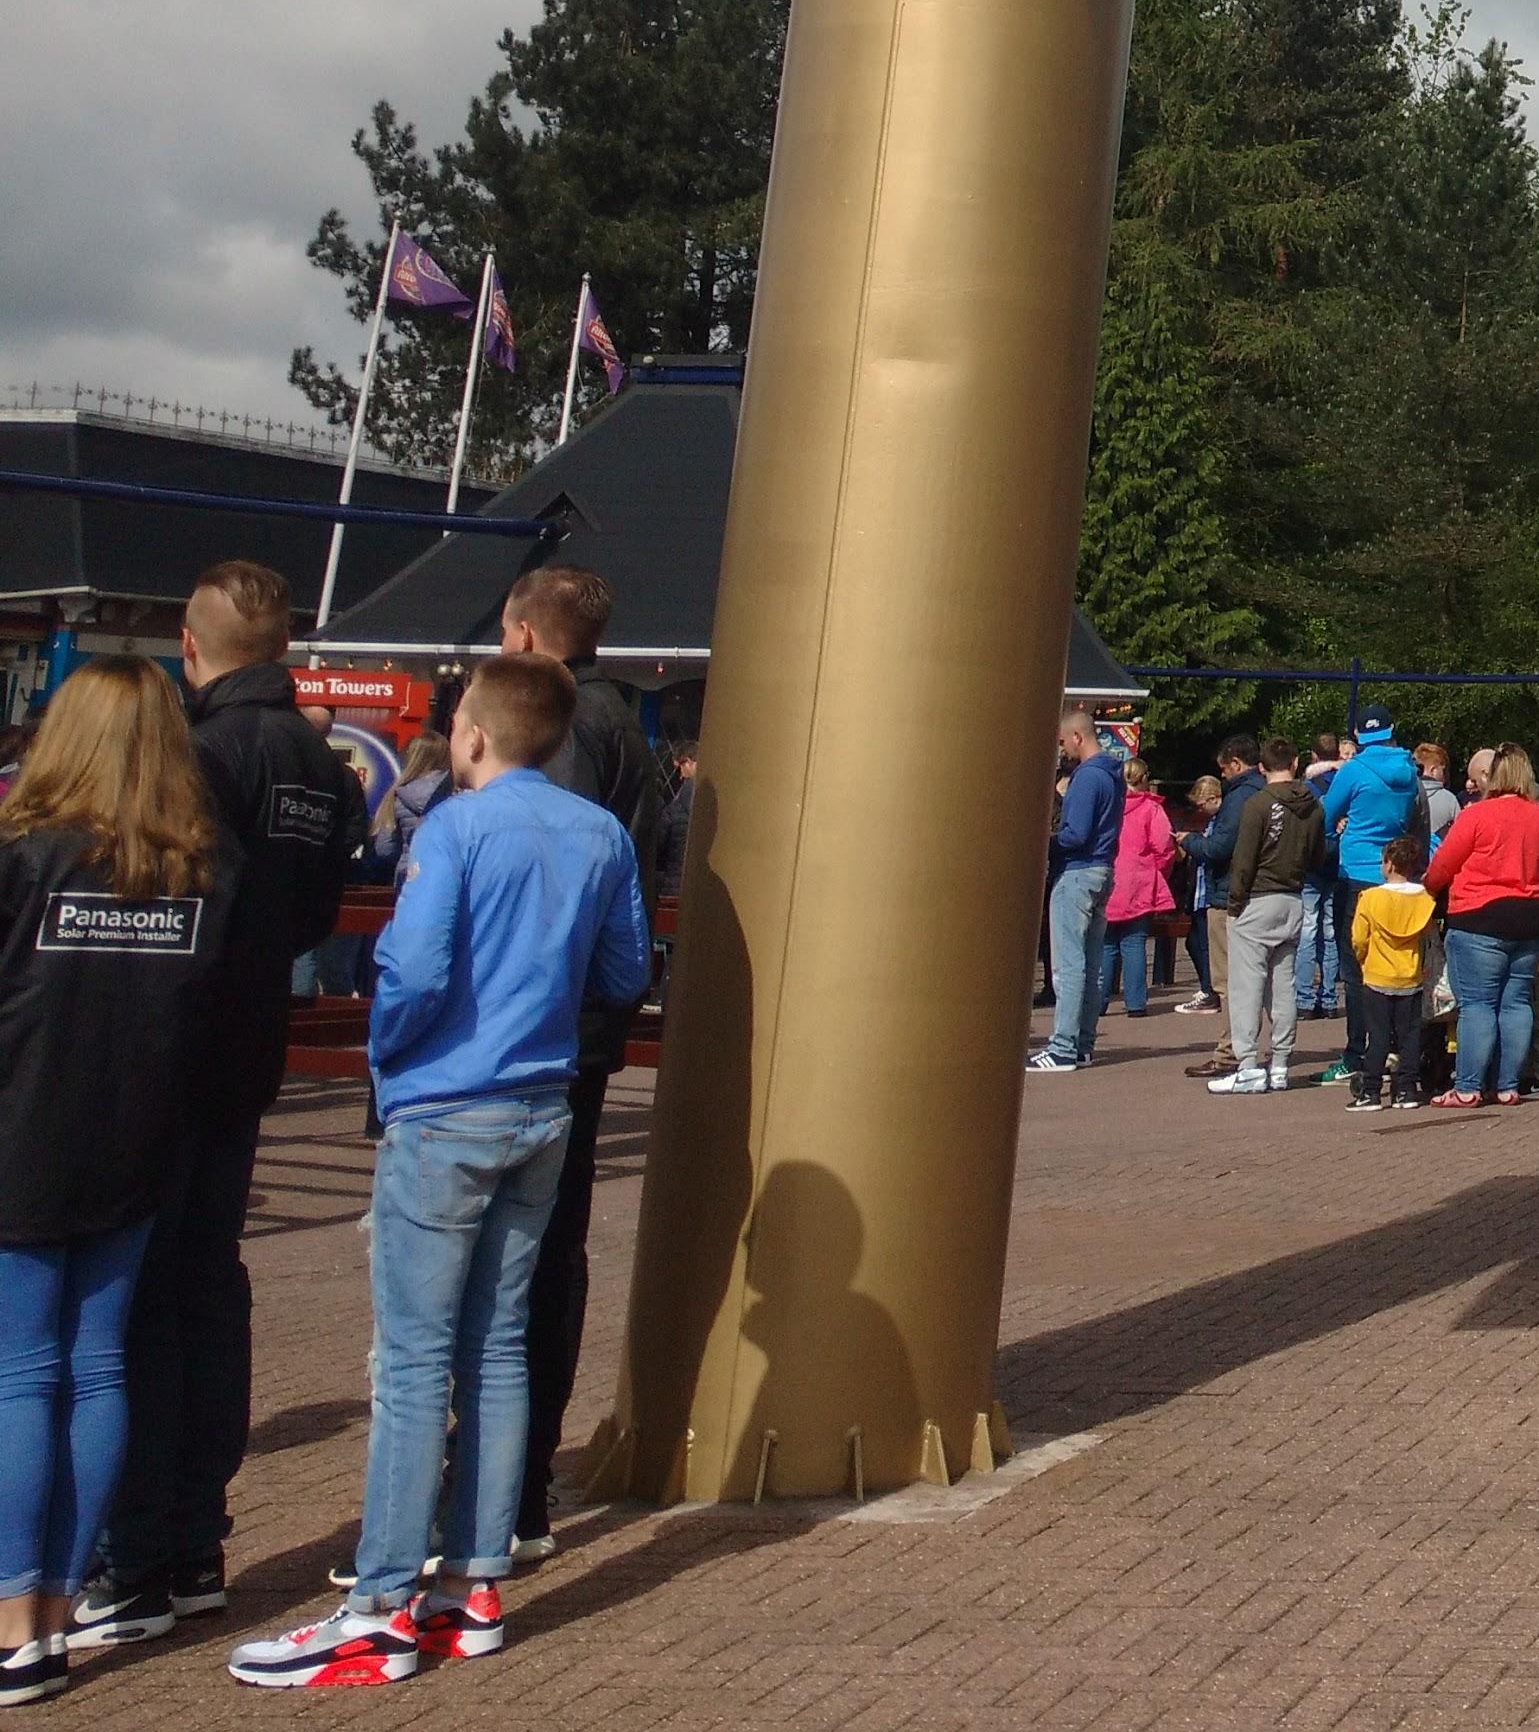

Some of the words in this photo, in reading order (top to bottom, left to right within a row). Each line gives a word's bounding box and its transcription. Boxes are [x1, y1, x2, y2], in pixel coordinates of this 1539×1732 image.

[325, 677, 394, 697] Towers
[58, 904, 185, 929] Panasonic
[56, 928, 85, 939] Solar
[87, 929, 135, 941] Premium
[137, 930, 182, 942] Installer
